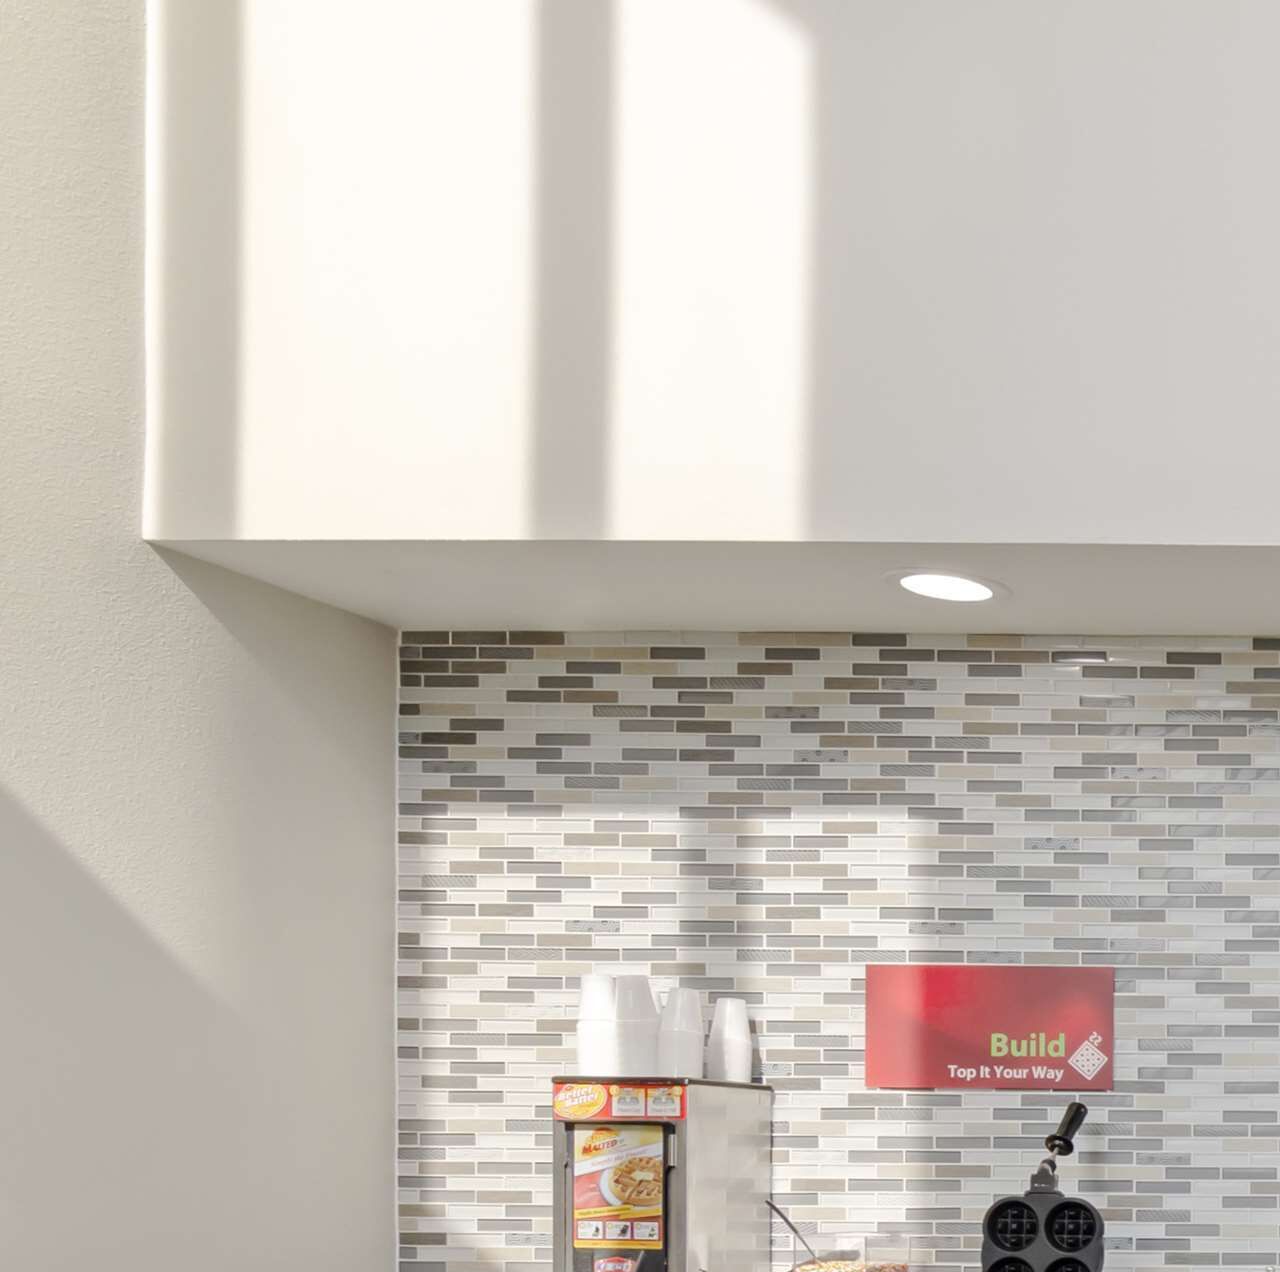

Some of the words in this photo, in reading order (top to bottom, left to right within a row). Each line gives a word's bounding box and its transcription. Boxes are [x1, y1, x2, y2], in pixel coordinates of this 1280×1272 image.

[990, 1032, 1065, 1057] Build
[947, 1065, 977, 1081] Top
[980, 1065, 991, 1079] It
[994, 1066, 1029, 1079] Your
[1032, 1066, 1064, 1082] Way
[582, 1139, 618, 1154] MALTED
